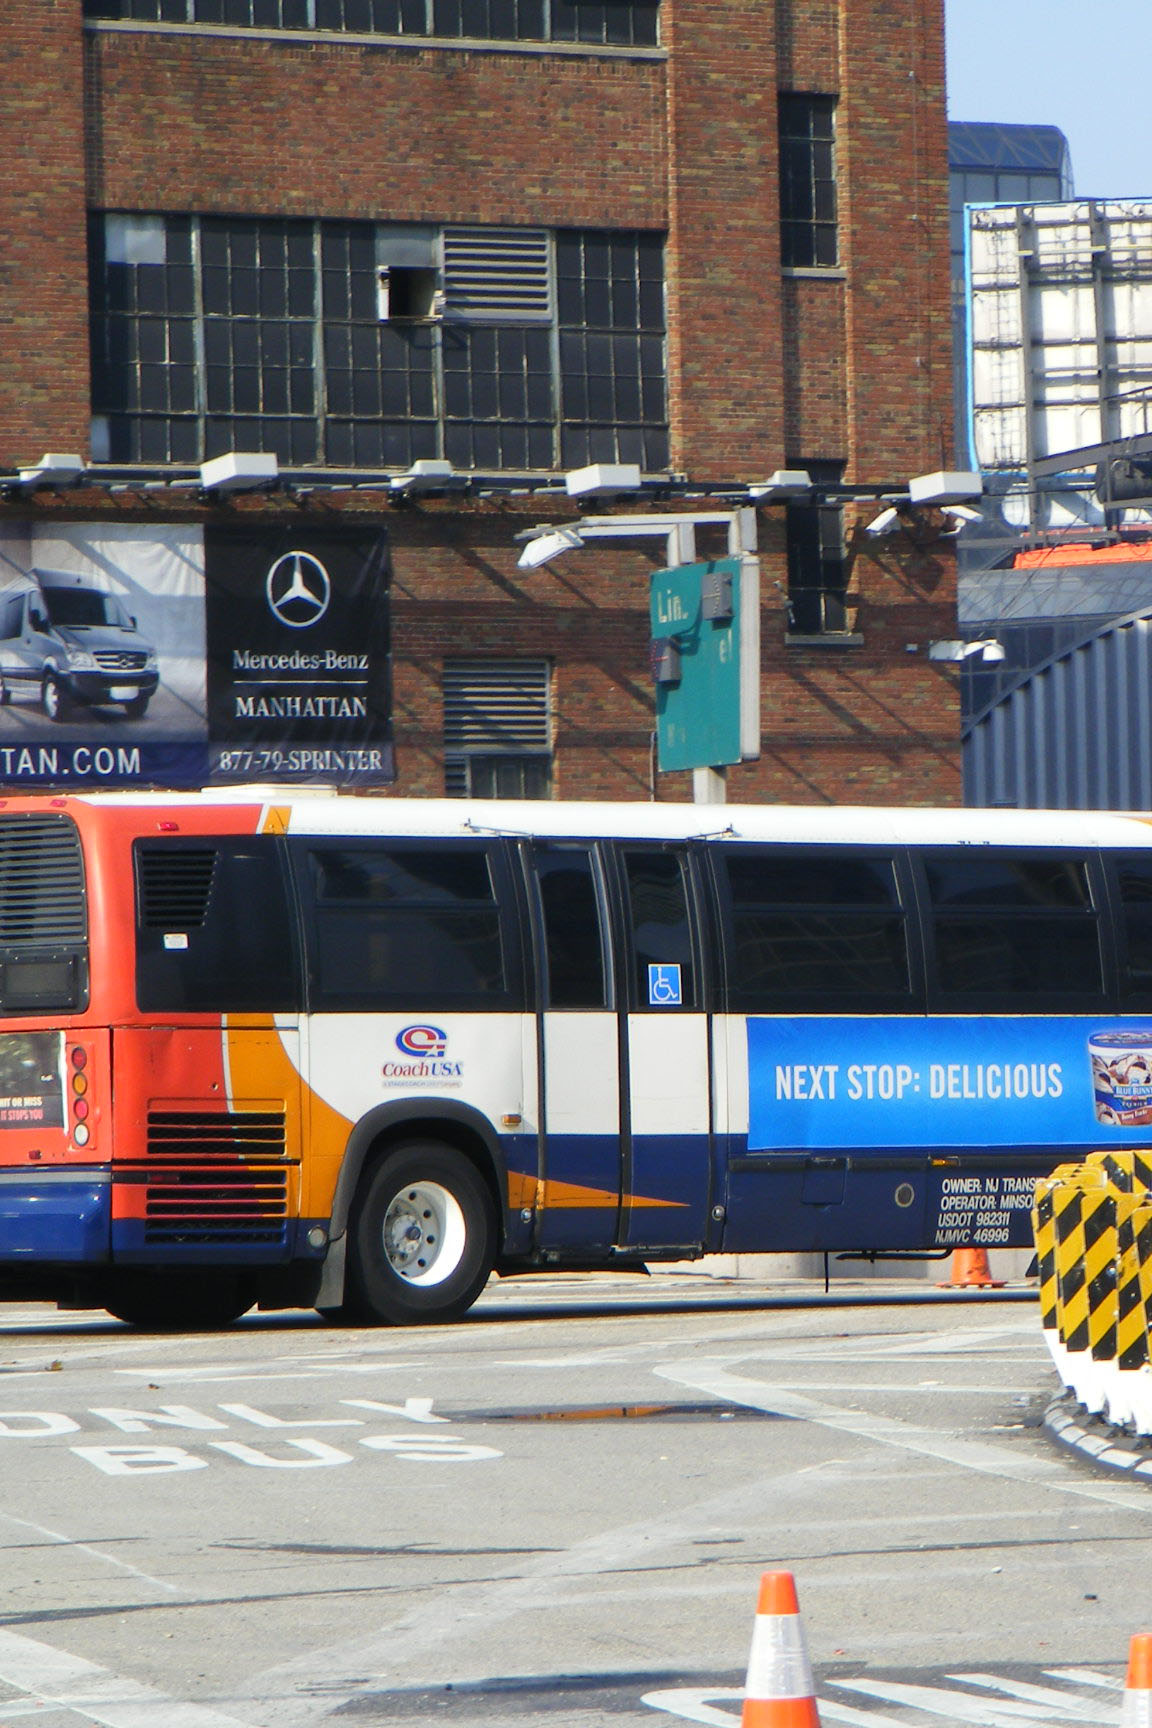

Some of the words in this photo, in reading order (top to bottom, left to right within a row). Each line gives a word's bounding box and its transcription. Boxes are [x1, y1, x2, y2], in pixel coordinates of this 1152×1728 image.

[233, 650, 368, 670] Mercedes-Benz
[235, 697, 367, 717] MANHATTAN
[220, 750, 382, 770] 877-79-SPRINTER
[383, 1062, 429, 1077] Coach
[432, 1062, 462, 1076] USA
[775, 1065, 838, 1101] NEXT
[848, 1064, 921, 1100] STOP:
[930, 1063, 1063, 1099] DELICIOUS
[942, 1178, 982, 1193] OWNER:
[985, 1178, 999, 1192] NJ
[1002, 1177, 1037, 1192] TRANS
[941, 1195, 997, 1210] OPERATOR:
[938, 1212, 974, 1227] USDOT
[976, 1211, 1010, 1226] 982311
[935, 1229, 971, 1244] NJMVC
[973, 1228, 1009, 1242] 46996
[0, 1398, 451, 1438] ONLY
[70, 1434, 504, 1476] BUS
